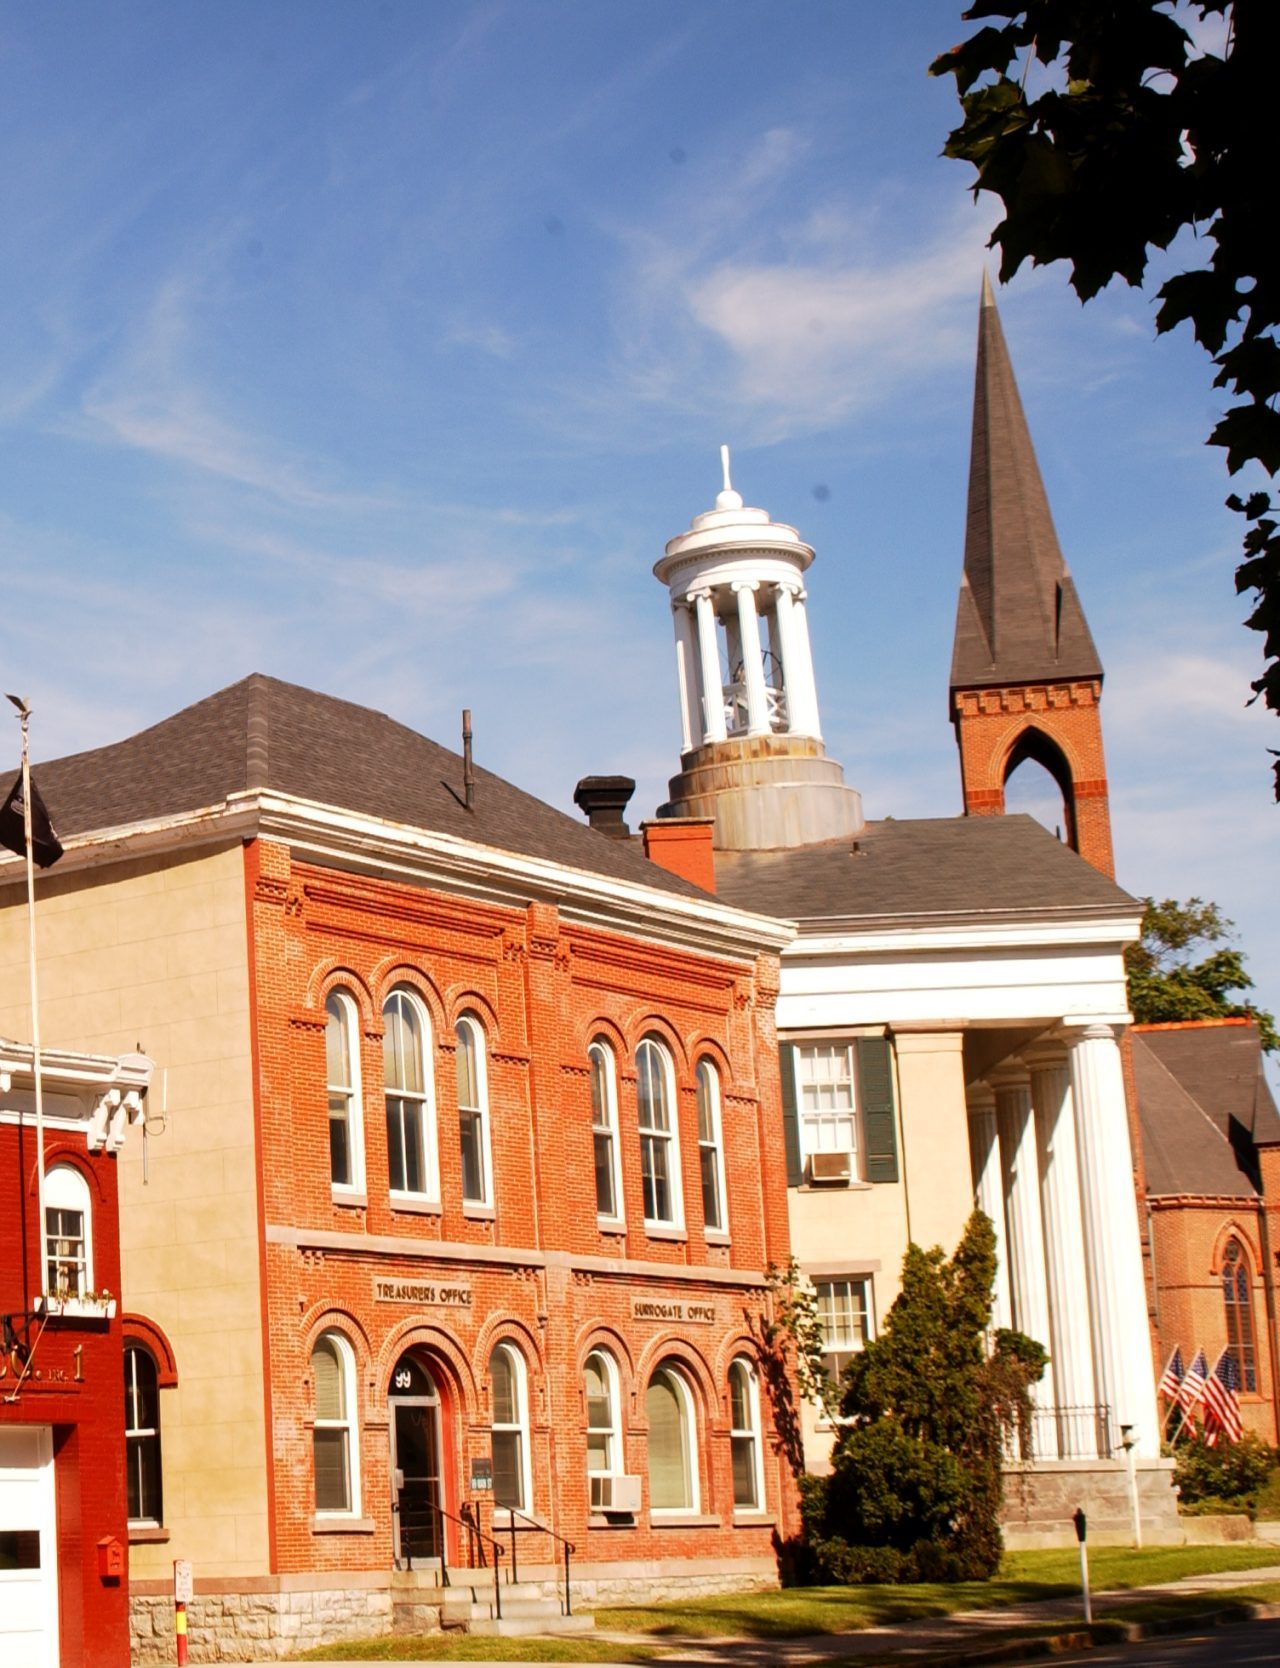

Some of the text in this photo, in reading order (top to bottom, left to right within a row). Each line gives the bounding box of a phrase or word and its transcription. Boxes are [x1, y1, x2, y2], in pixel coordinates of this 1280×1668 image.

[439, 1288, 473, 1305] OFFICE
[634, 1303, 716, 1321] SURROGATE OFFICE
[73, 1343, 84, 1382] 1
[394, 1368, 411, 1388] 99
